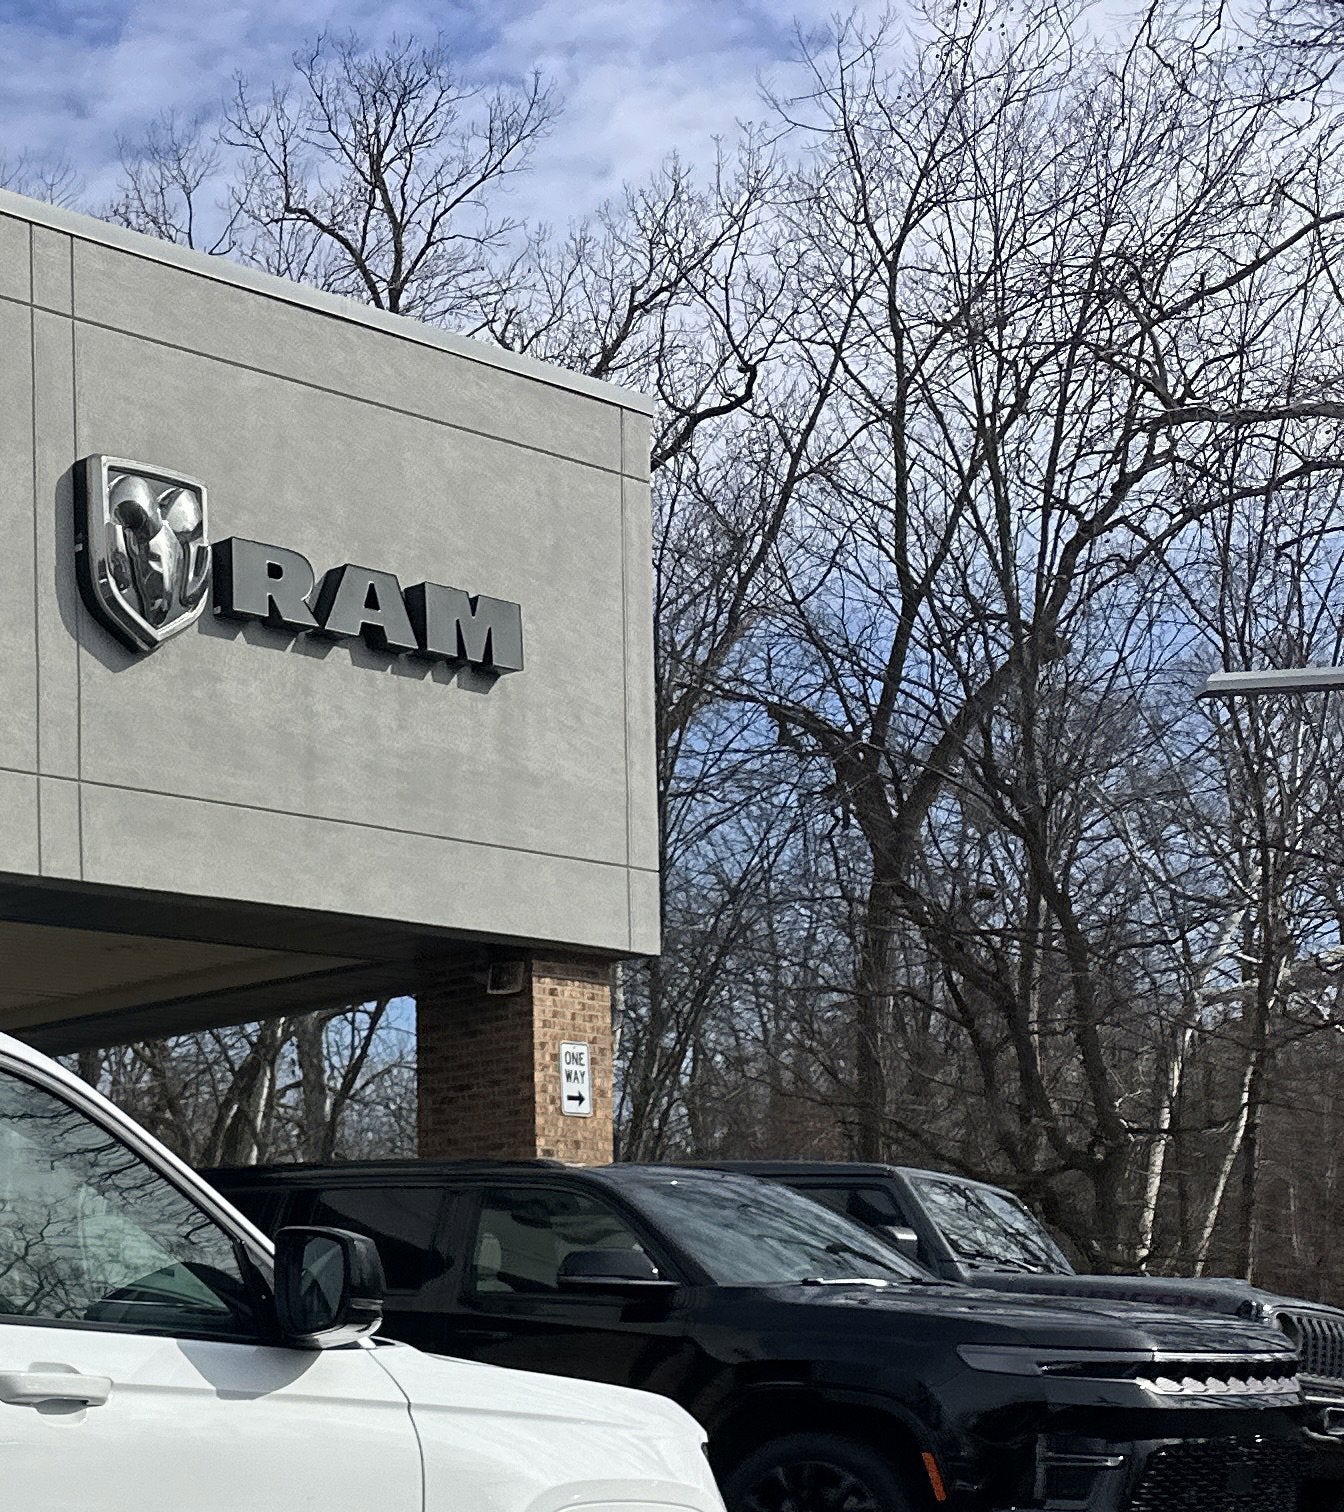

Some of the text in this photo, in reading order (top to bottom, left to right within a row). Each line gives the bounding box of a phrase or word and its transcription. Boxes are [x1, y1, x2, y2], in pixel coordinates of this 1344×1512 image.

[215, 536, 523, 672] RAM
[564, 1050, 586, 1067] ONE
[564, 1069, 586, 1084] WAY
